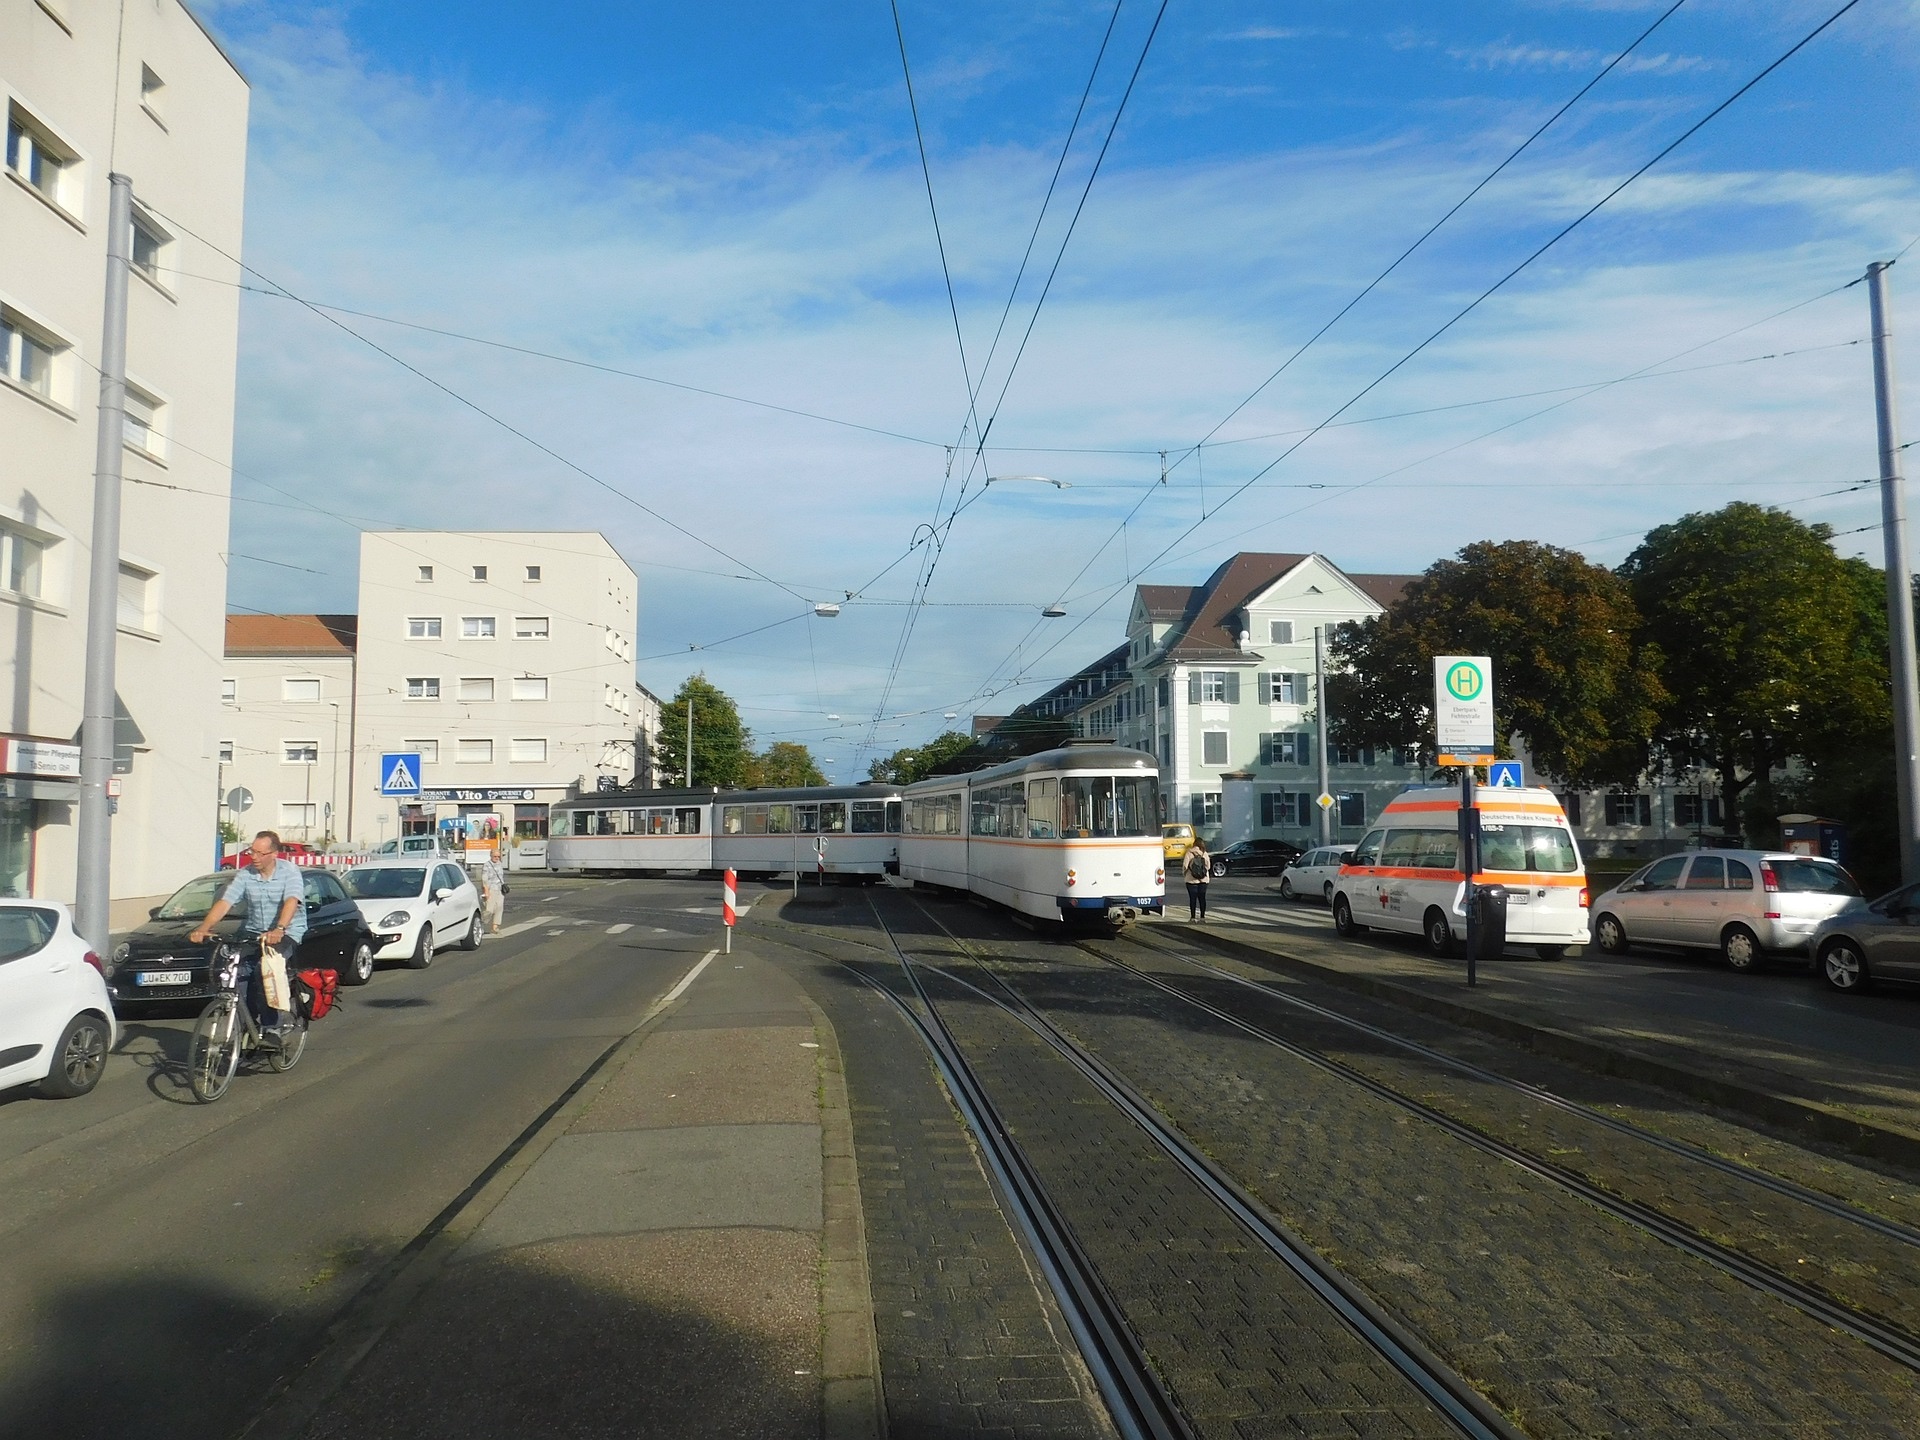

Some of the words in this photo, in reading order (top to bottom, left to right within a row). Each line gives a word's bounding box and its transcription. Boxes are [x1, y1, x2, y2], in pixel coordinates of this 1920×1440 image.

[1457, 670, 1473, 692] H
[51, 749, 81, 760] Pflegedien
[455, 790, 483, 800] Vito
[1830, 840, 1839, 859] ets
[143, 974, 154, 982] LU
[160, 974, 170, 982] EK
[173, 973, 190, 982] 700
